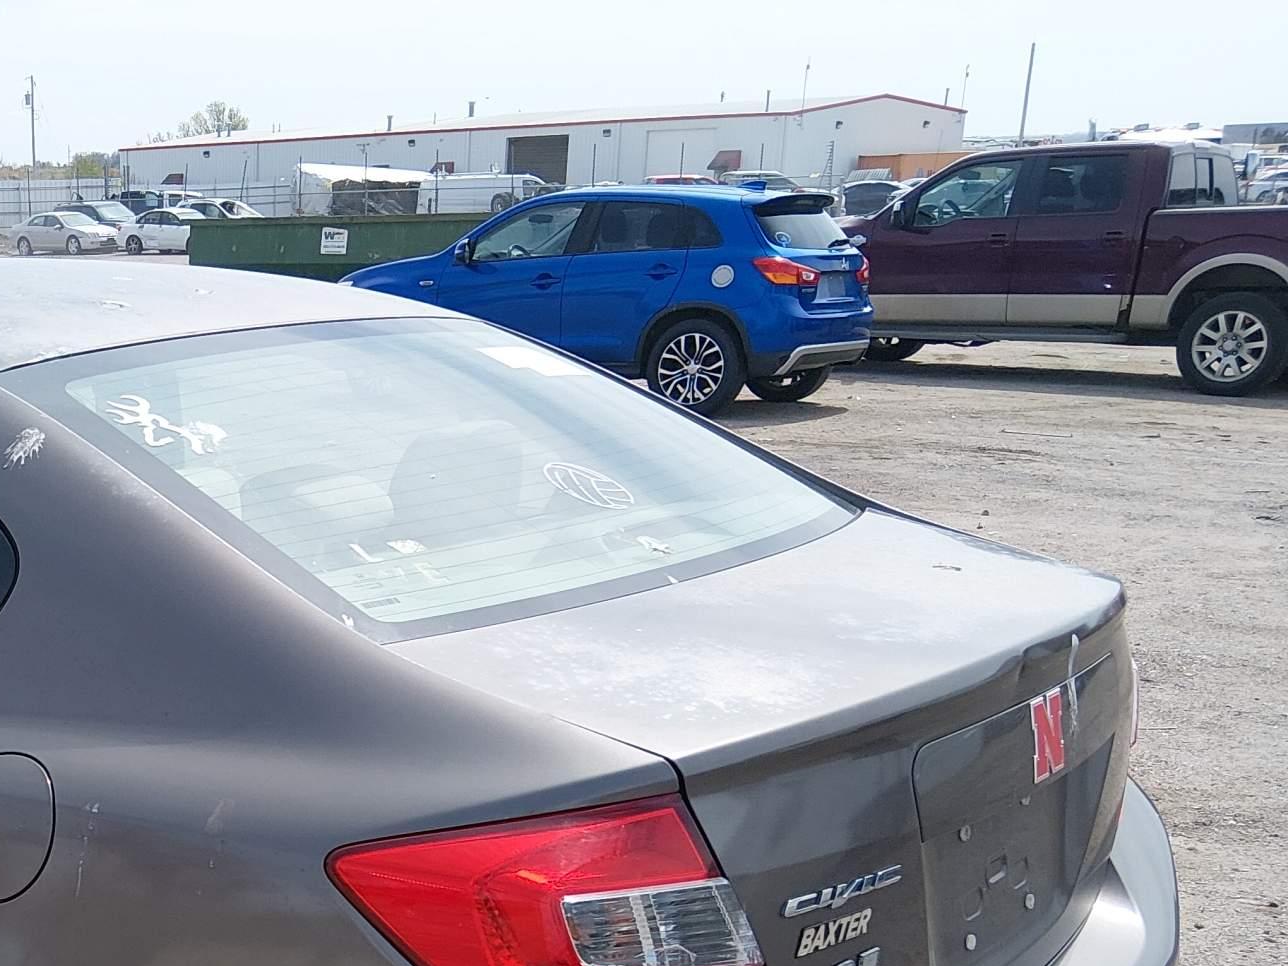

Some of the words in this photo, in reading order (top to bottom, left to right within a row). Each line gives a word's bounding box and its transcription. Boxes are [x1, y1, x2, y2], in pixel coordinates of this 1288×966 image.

[1030, 687, 1064, 784] N
[782, 864, 903, 918] CIVIC
[796, 908, 873, 958] BAXTER
